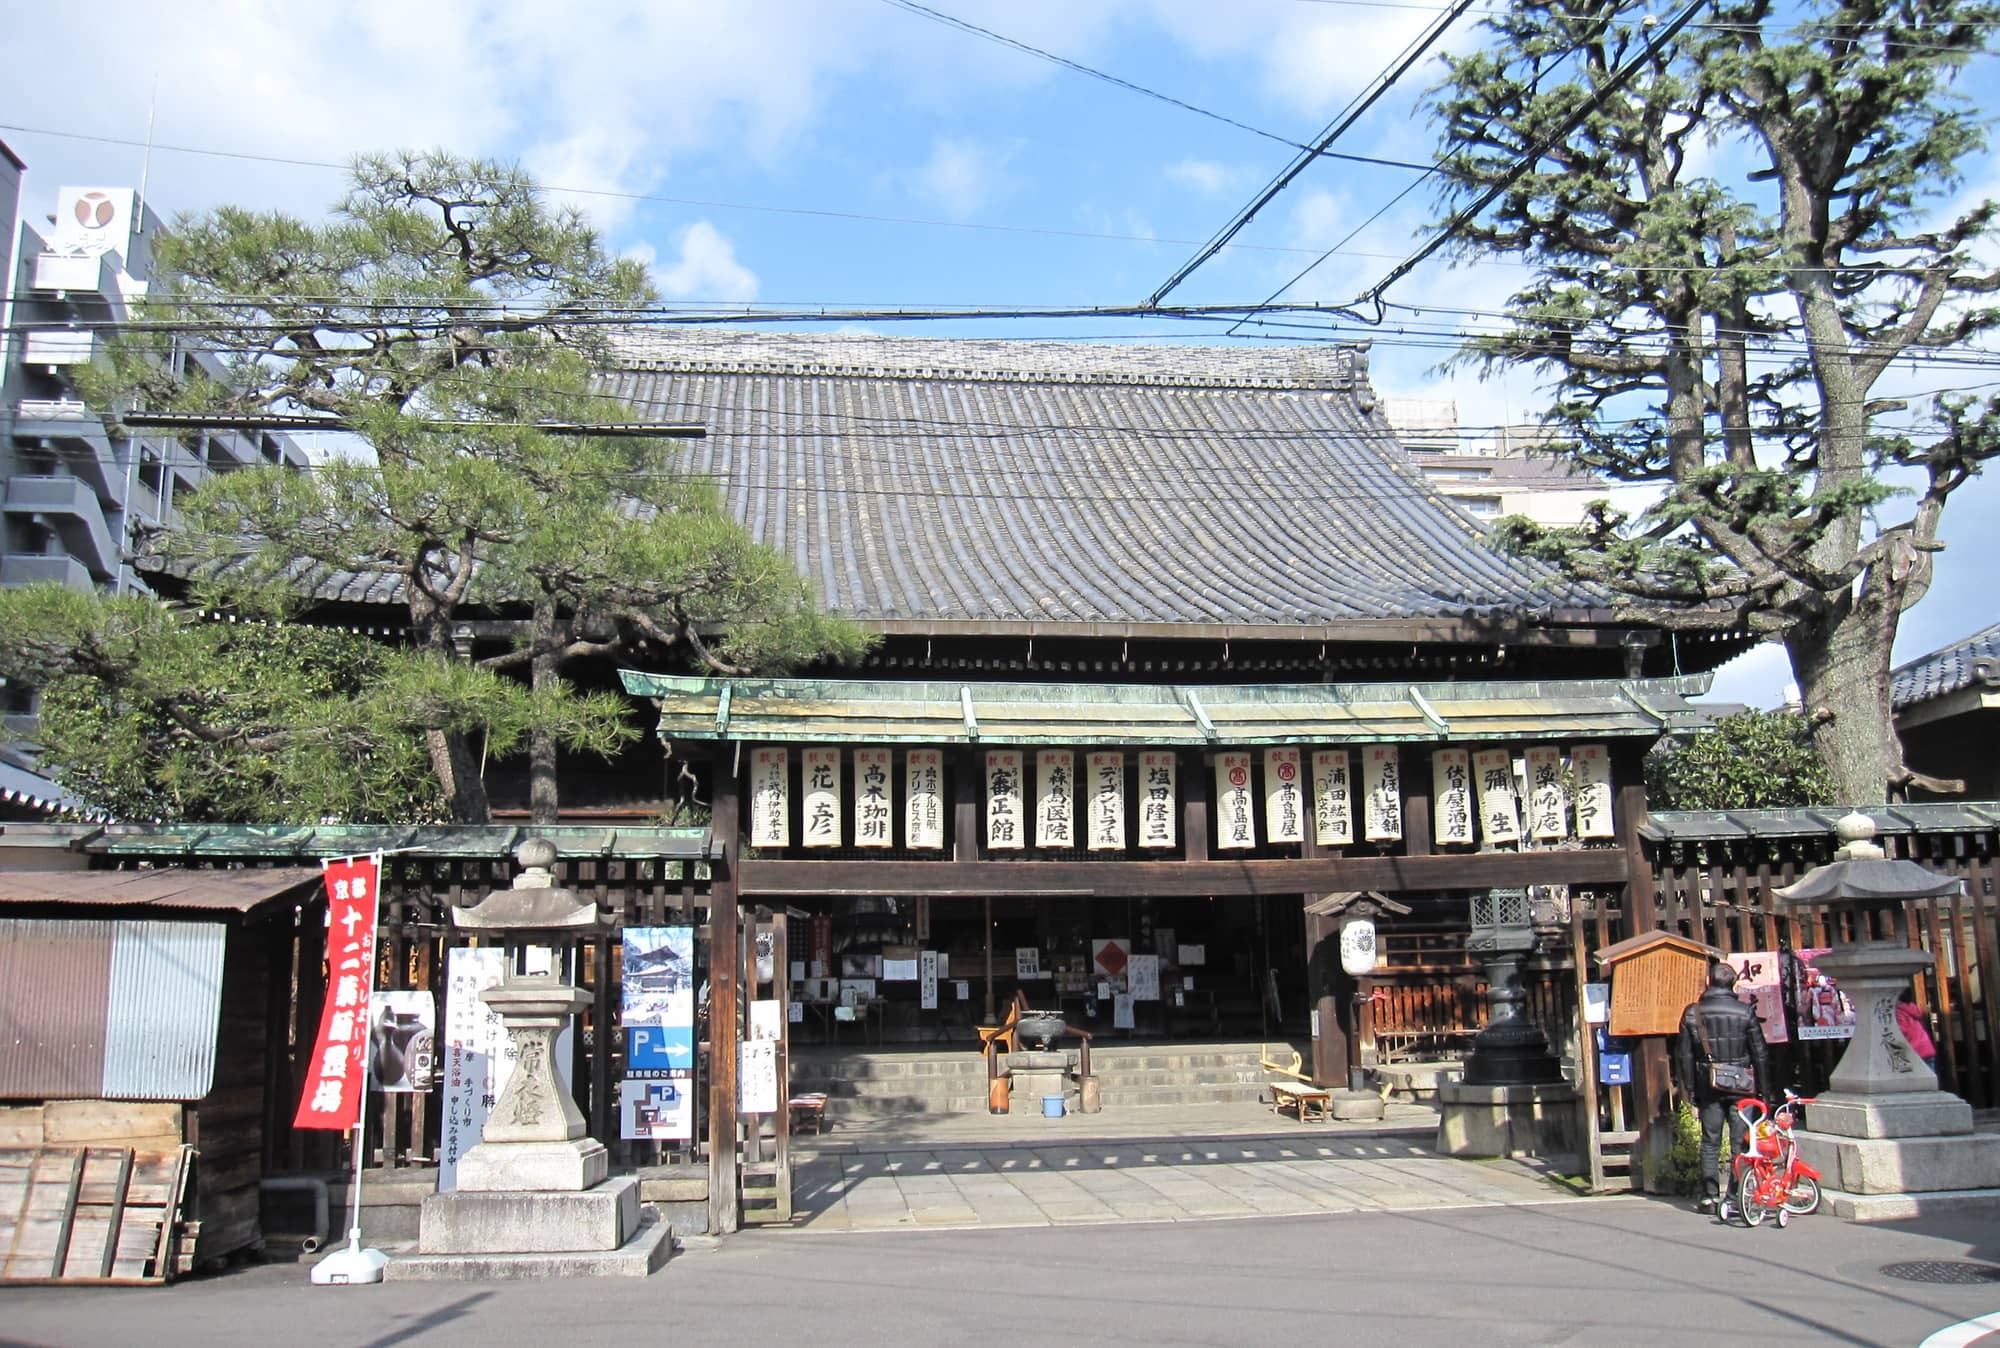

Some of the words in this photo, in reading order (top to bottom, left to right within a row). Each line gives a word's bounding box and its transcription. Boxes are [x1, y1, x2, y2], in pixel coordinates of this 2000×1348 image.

[810, 764, 834, 835] 花彦
[863, 764, 888, 839] 高木珈琲
[1147, 768, 1170, 840] 塩田隆三
[1445, 765, 1467, 838] 伏見屋酒店
[334, 877, 367, 900] 京都
[351, 933, 372, 1060] おやくしまいり
[634, 1031, 649, 1057] P
[463, 1078, 474, 1127] 手づくり市
[662, 1088, 672, 1100] P
